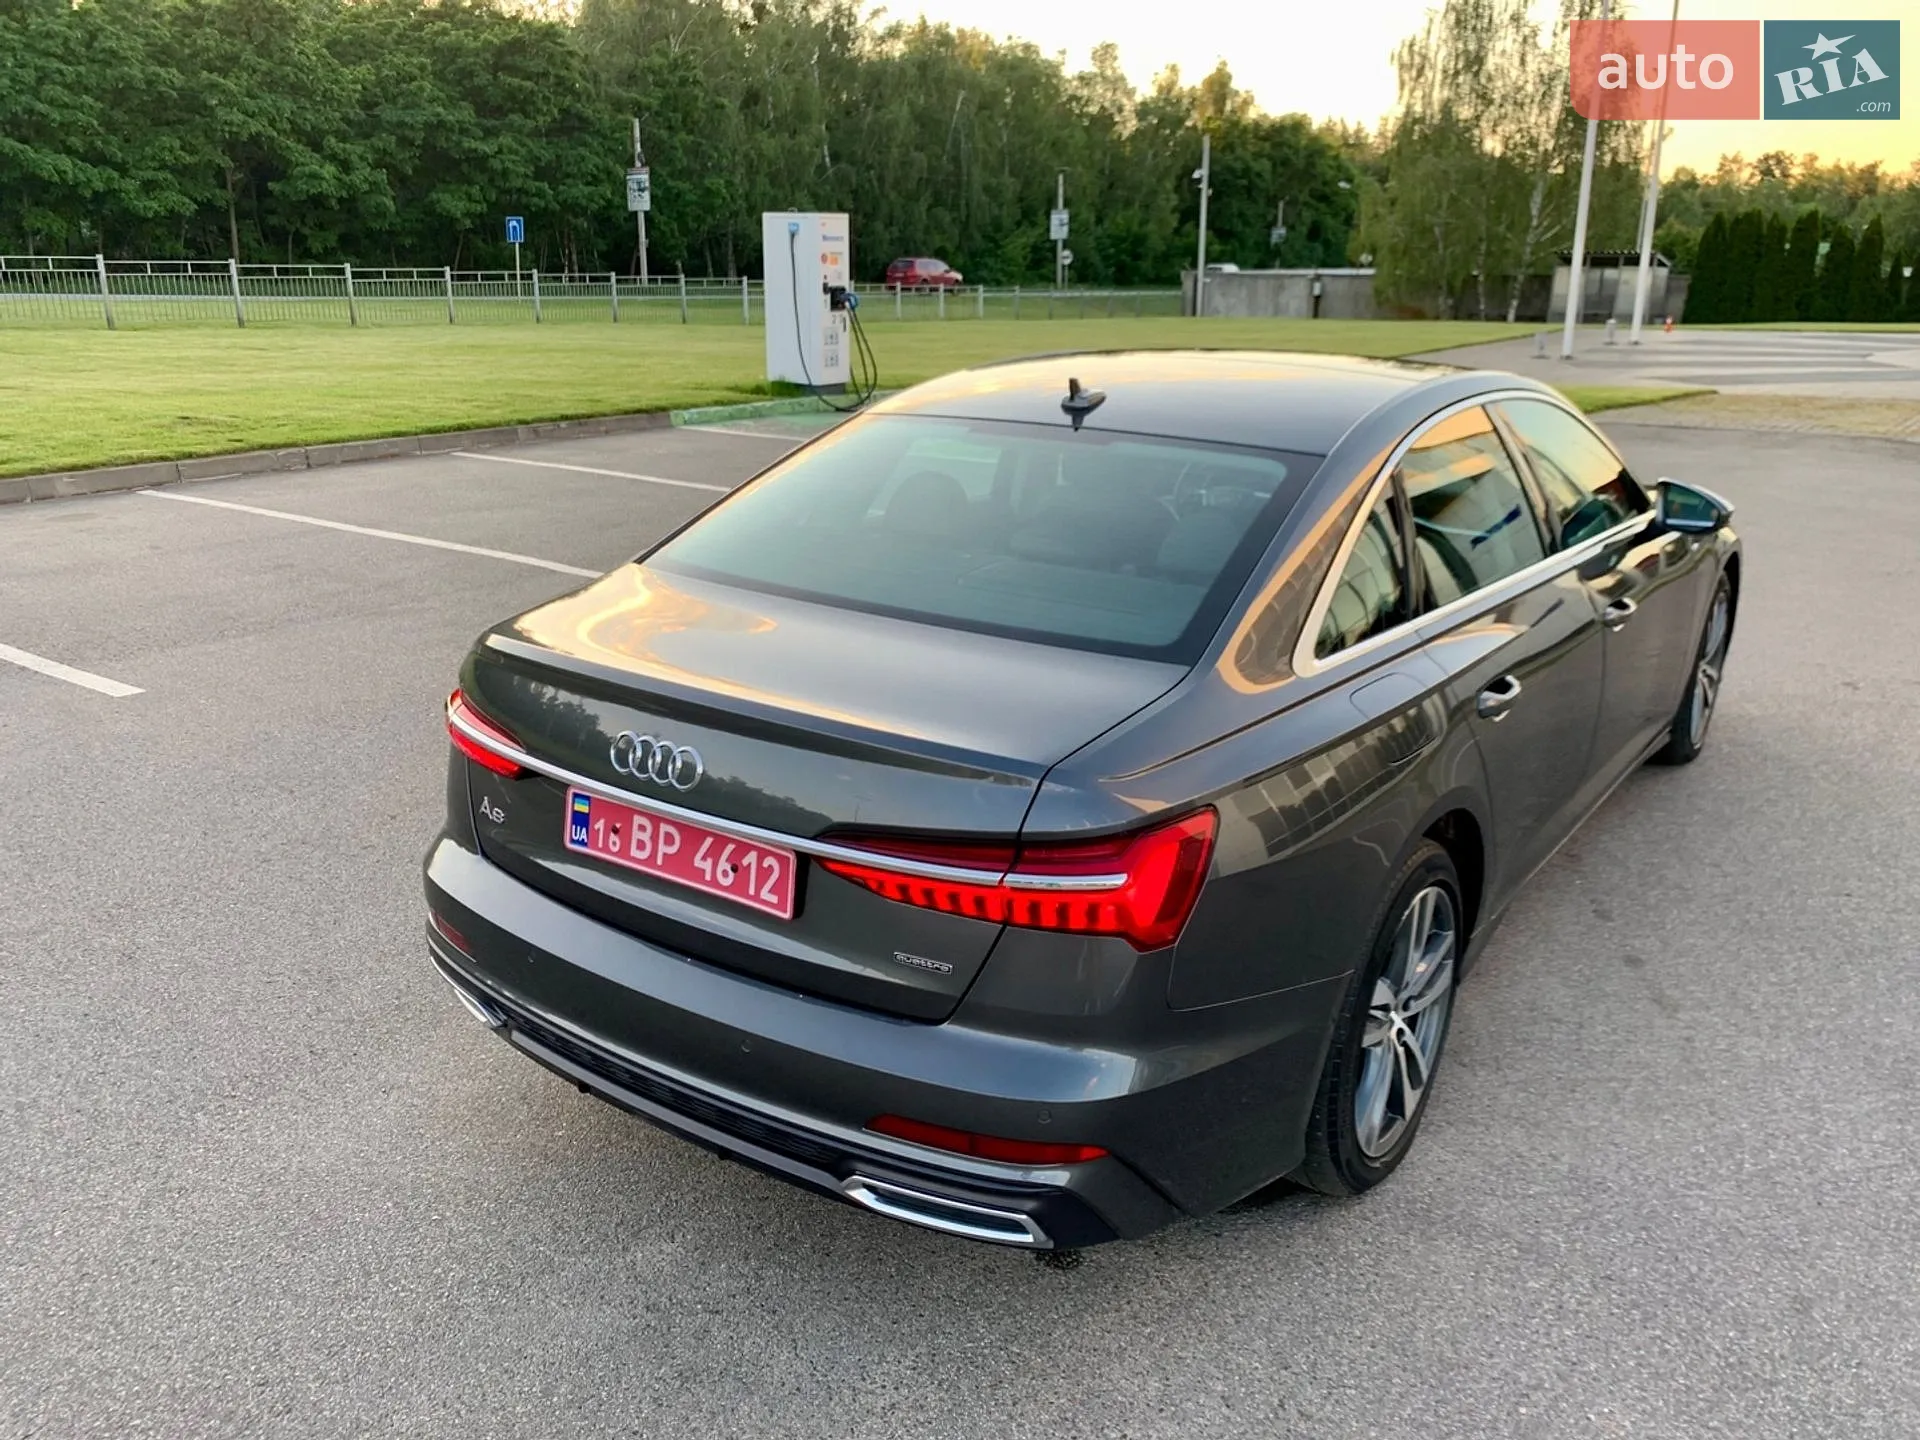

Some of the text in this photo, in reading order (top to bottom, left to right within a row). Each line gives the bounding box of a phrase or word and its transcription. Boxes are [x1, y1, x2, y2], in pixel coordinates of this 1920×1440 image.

[480, 796, 505, 823] A6
[572, 824, 588, 843] UA
[630, 814, 681, 866] BP
[693, 837, 779, 904] 4612
[895, 953, 950, 972] quattro
